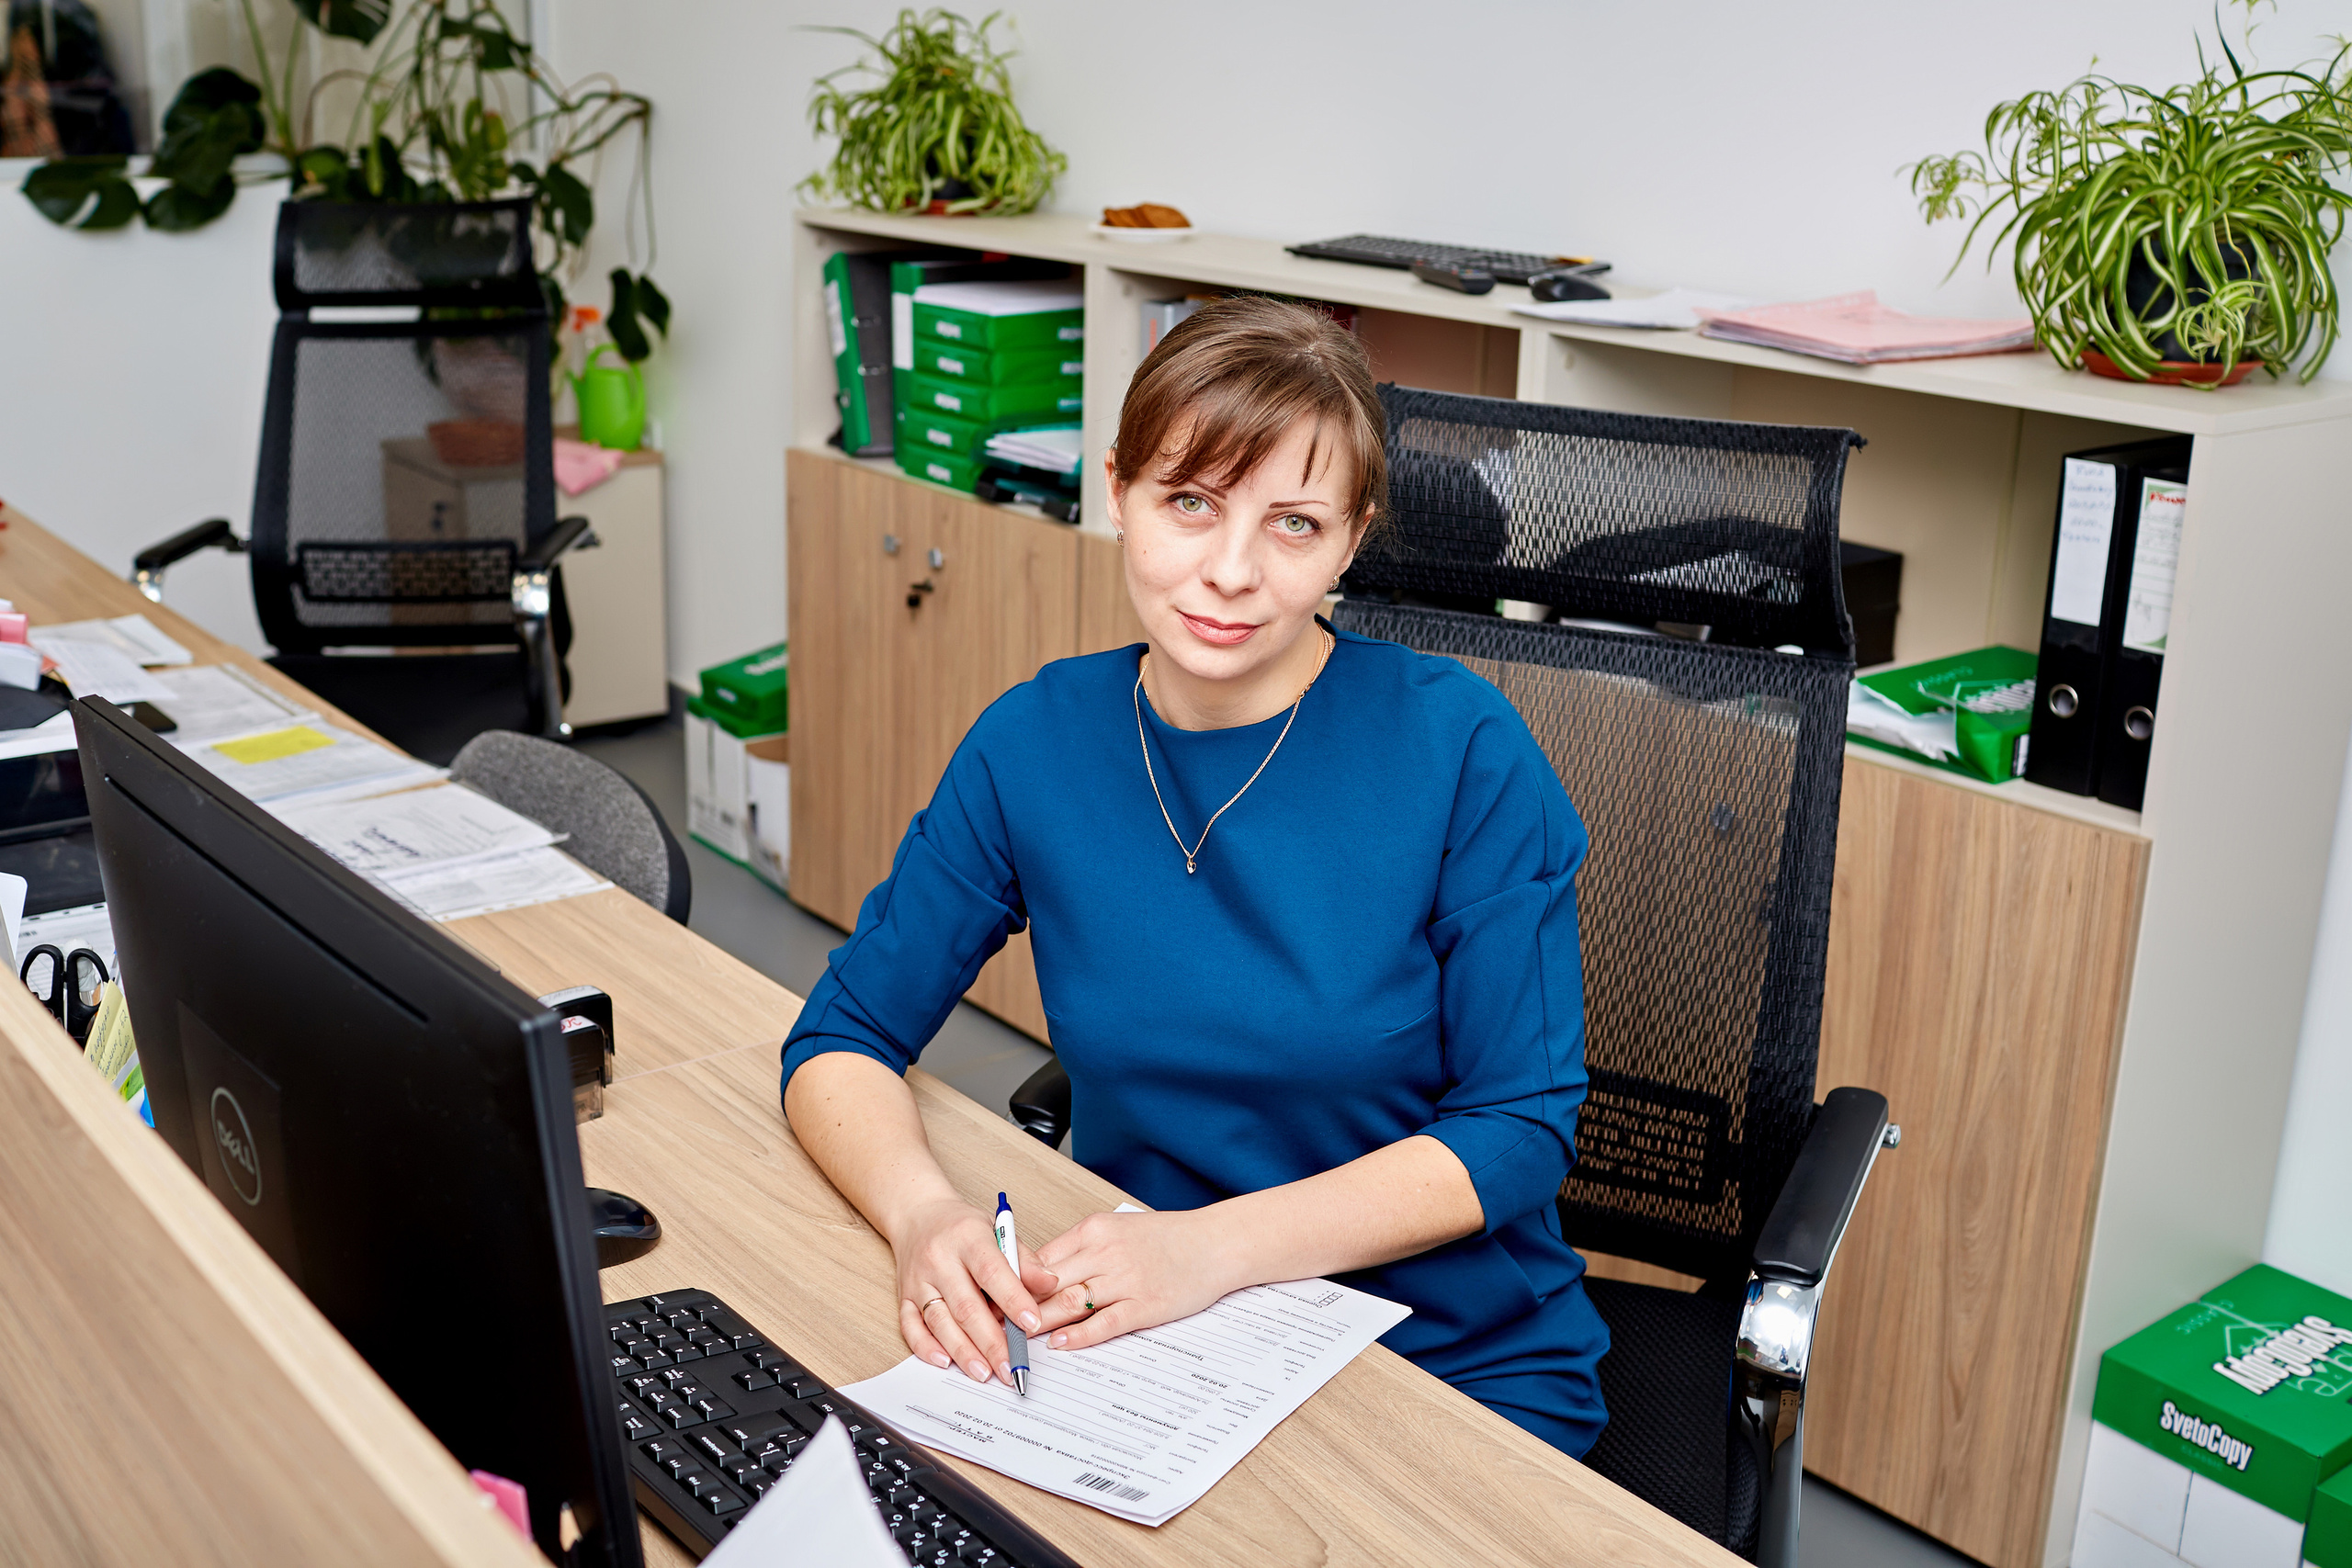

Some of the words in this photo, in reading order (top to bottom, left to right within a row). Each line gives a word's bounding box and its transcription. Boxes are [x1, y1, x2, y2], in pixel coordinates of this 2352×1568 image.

[1267, 1287, 1296, 1299] качества
[1298, 1298, 1322, 1308] Оценка
[1153, 1341, 1204, 1361] Транспортная
[2213, 1315, 2352, 1395] SvetoCopy
[1191, 1374, 1227, 1388] 20.02.2020
[668, 1408, 681, 1418] Insert
[700, 1401, 713, 1411] Delete
[1224, 1408, 1249, 1418] Менеджер
[955, 1411, 993, 1427] 20.02.2020
[1140, 1416, 1179, 1430] документы
[734, 1429, 748, 1439] Enter
[950, 1427, 986, 1443] МАСТЕР
[1003, 1430, 1042, 1447] 000009702
[2160, 1401, 2254, 1472] SvetoCopy
[651, 1443, 662, 1451] F12
[702, 1437, 725, 1456] Backspace
[670, 1460, 681, 1468] F11
[1057, 1450, 1130, 1479] Экспресс-доставка
